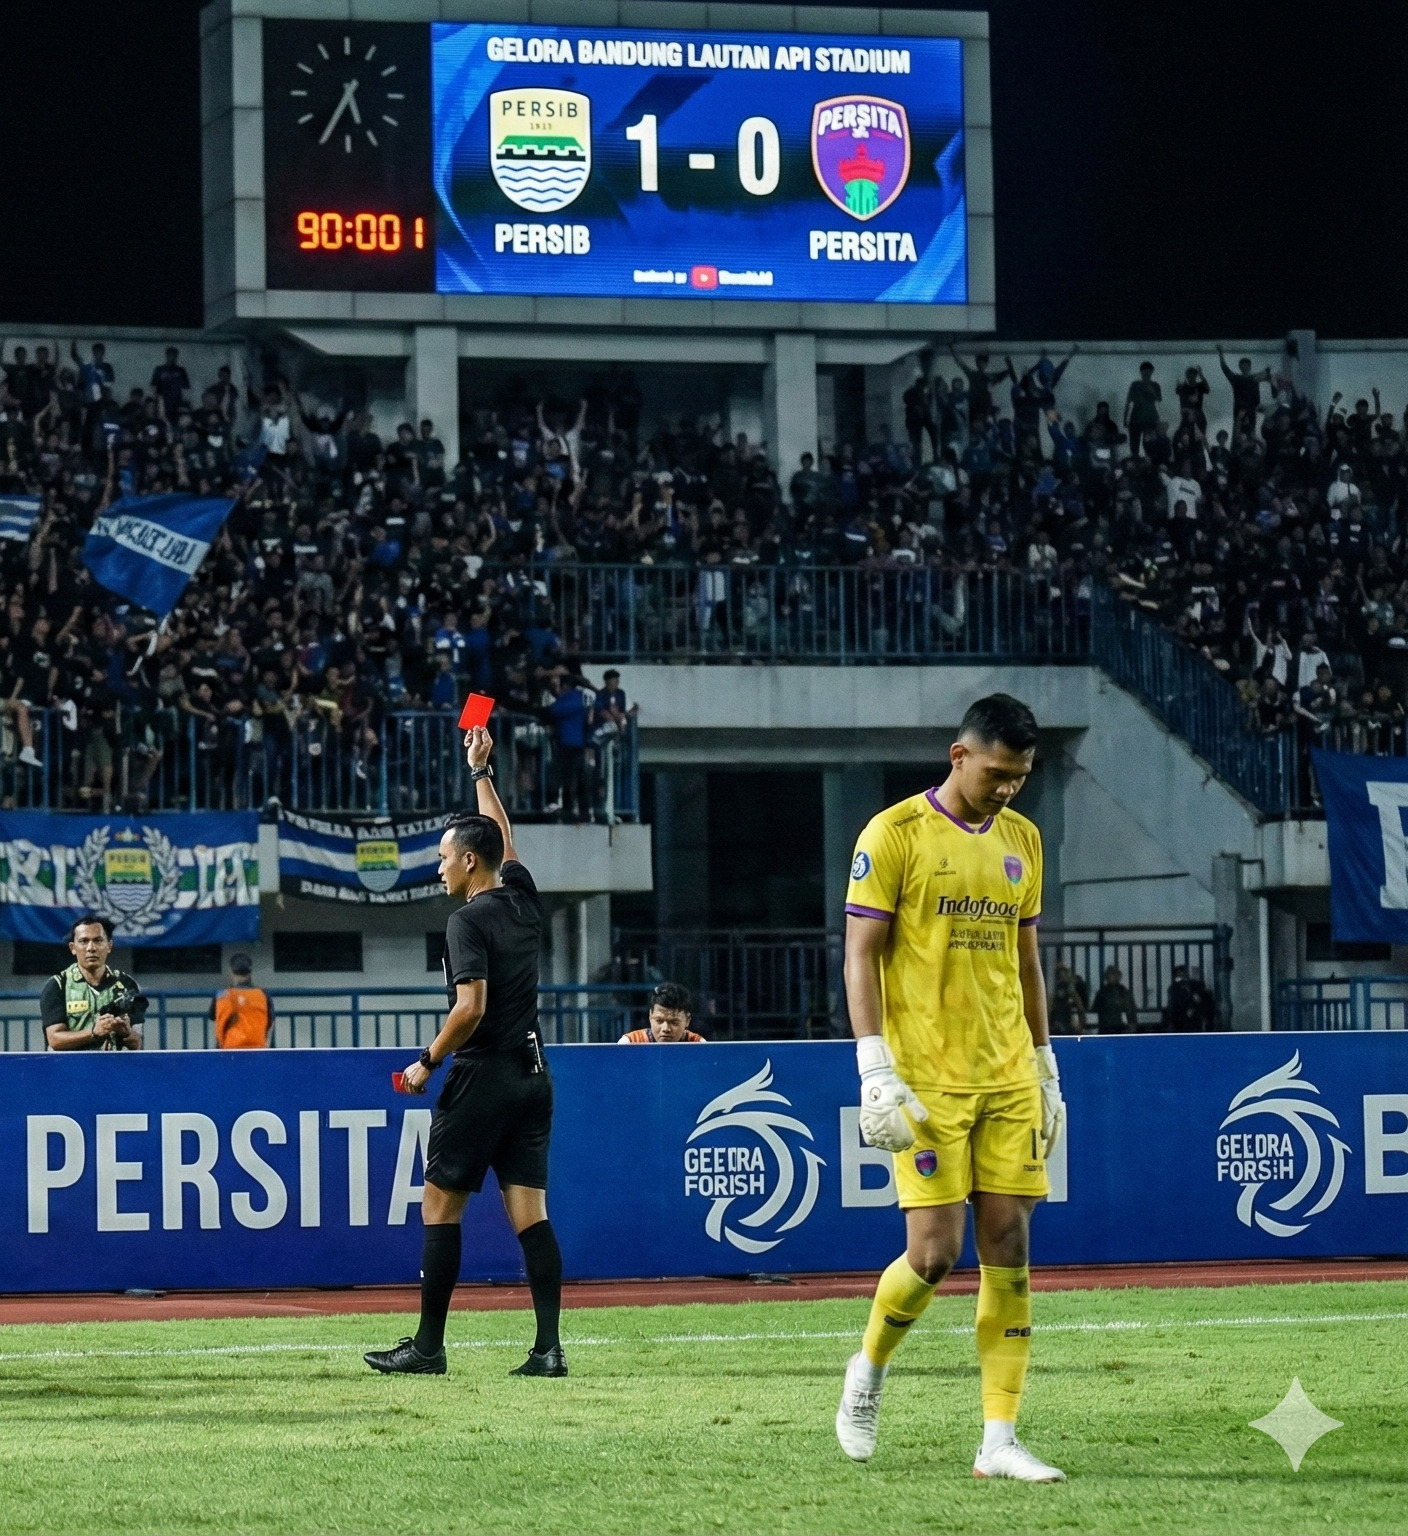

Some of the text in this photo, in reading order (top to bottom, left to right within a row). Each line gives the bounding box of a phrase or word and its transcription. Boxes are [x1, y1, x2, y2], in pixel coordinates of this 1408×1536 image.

[487, 37, 911, 74] GELORA BANDUNG LAUTAN API STADIUM
[502, 101, 578, 118] PERSIB
[626, 113, 659, 193] 1
[737, 115, 781, 197] 0
[297, 212, 401, 251] 90:00
[494, 223, 591, 255] PERSIB
[809, 230, 918, 263] PERSITA
[684, 1173, 766, 1197] FORISH
